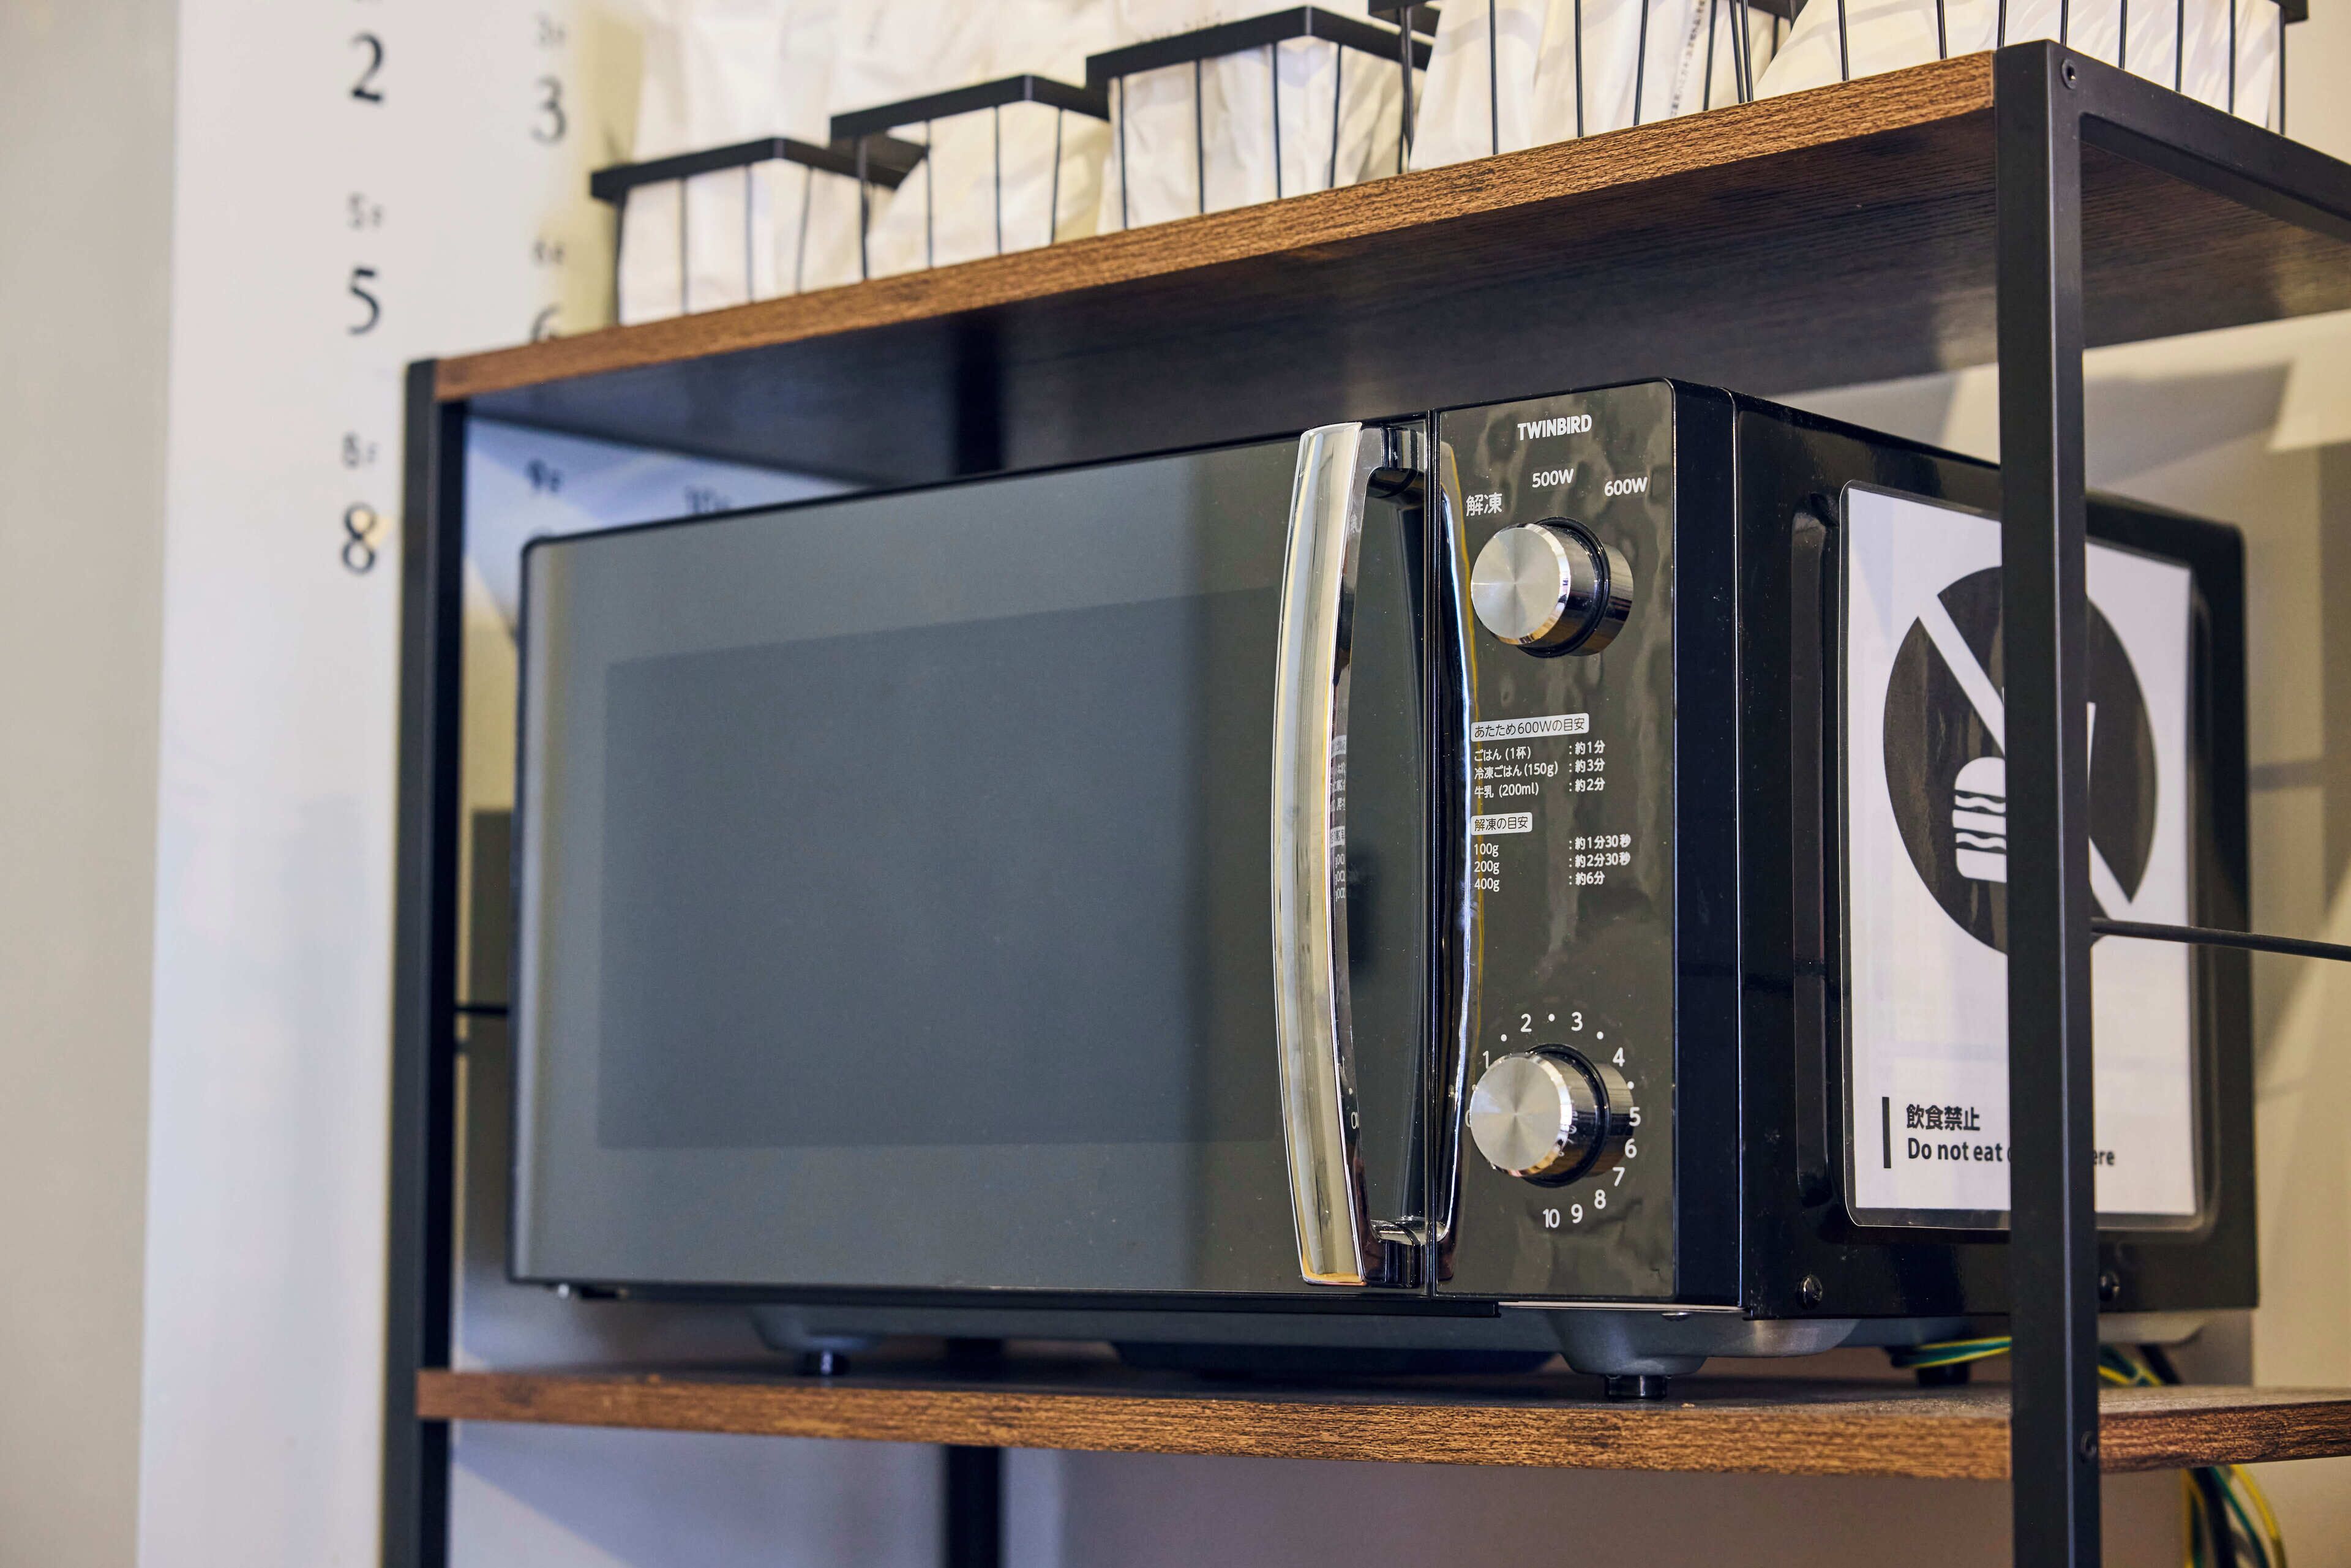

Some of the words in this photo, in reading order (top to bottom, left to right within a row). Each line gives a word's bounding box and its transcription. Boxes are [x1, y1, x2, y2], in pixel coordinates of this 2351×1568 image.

[350, 32, 385, 105] 2
[531, 76, 568, 146] 3
[348, 267, 381, 336] 5
[1517, 415, 1592, 441] TWINBIRD
[1532, 468, 1575, 488] 500W
[1604, 477, 1648, 497] 600W
[1466, 492, 1503, 517] 解凍
[341, 501, 378, 576] 8
[1474, 717, 1585, 738] あたため600Wの目安
[1474, 785, 1494, 799] 牛乳
[1499, 782, 1540, 798] (200ml)
[1474, 816, 1529, 832] 解凍の目安
[1474, 843, 1499, 858] 100g
[1474, 861, 1500, 876] 200g
[1474, 878, 1500, 893] 400g
[1521, 1013, 1532, 1033] 2
[1571, 1012, 1584, 1032] 3
[1482, 1050, 1490, 1070] 1
[1613, 1048, 1625, 1067] 4
[1629, 1107, 1641, 1127] 5
[1907, 1104, 1981, 1131] 飲食禁止
[1625, 1138, 1638, 1159] 6
[1908, 1138, 1933, 1160] Do
[1938, 1142, 1970, 1161] not
[1974, 1143, 2003, 1163] eat
[1613, 1167, 1625, 1187] 7
[1594, 1190, 1607, 1210] 8
[1543, 1209, 1561, 1229] 10
[1571, 1204, 1584, 1224] 9
